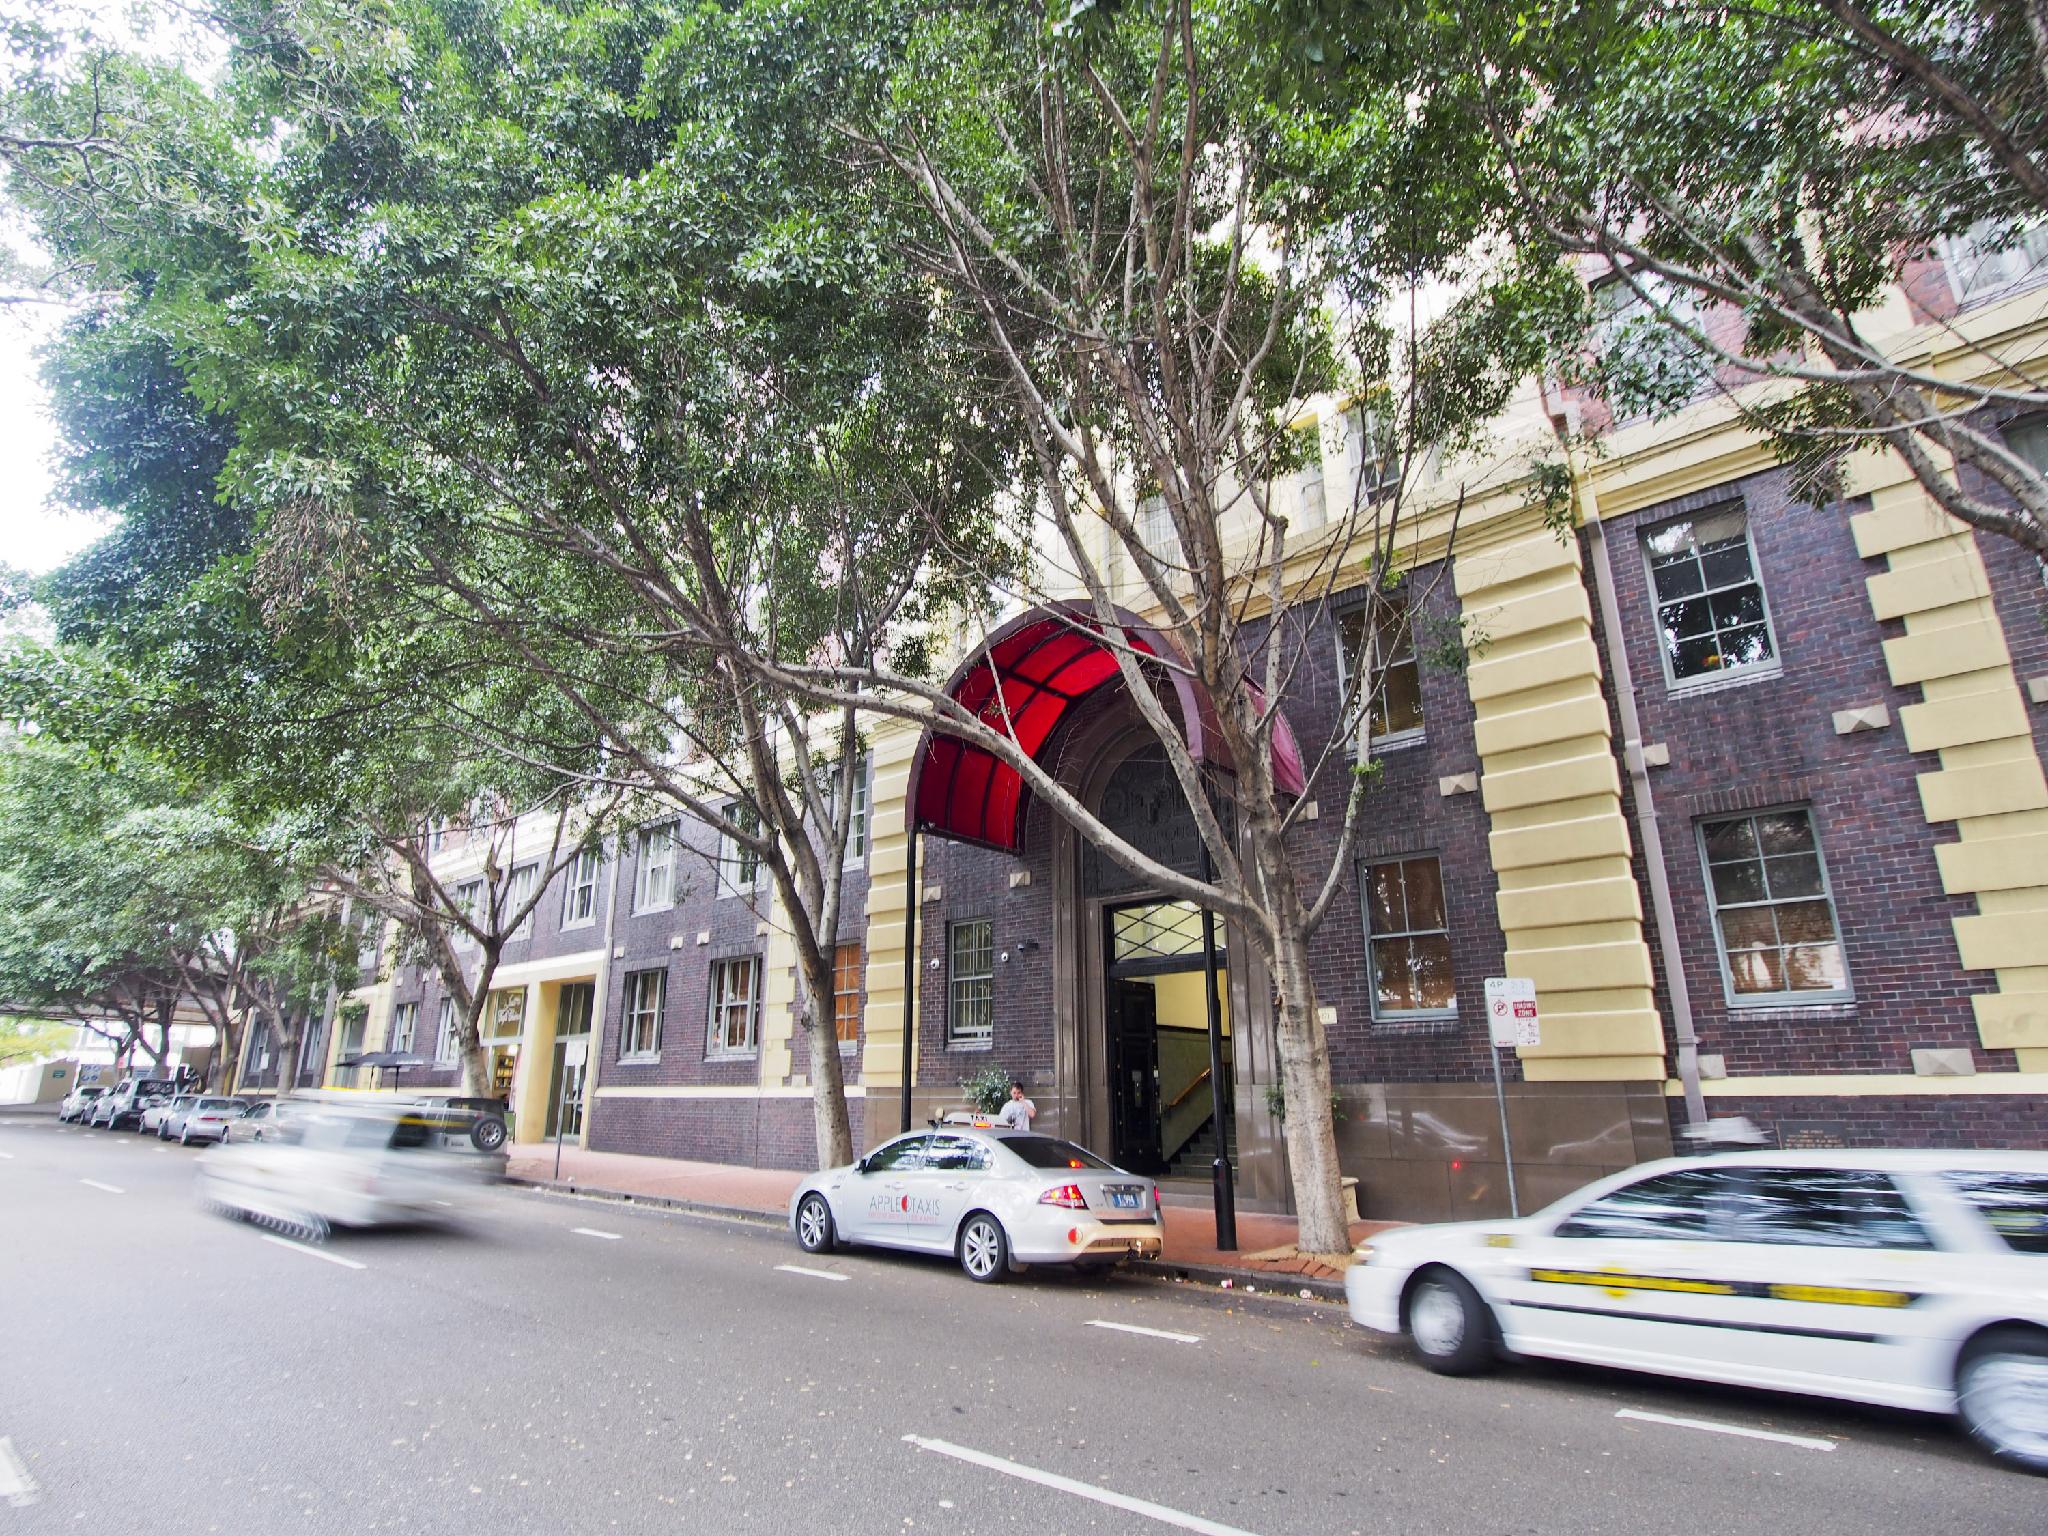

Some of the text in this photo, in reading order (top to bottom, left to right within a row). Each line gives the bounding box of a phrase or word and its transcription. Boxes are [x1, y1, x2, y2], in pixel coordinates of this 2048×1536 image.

[1517, 1009, 1533, 1017] ZONE
[869, 1195, 940, 1216] APPLE TAXIS
